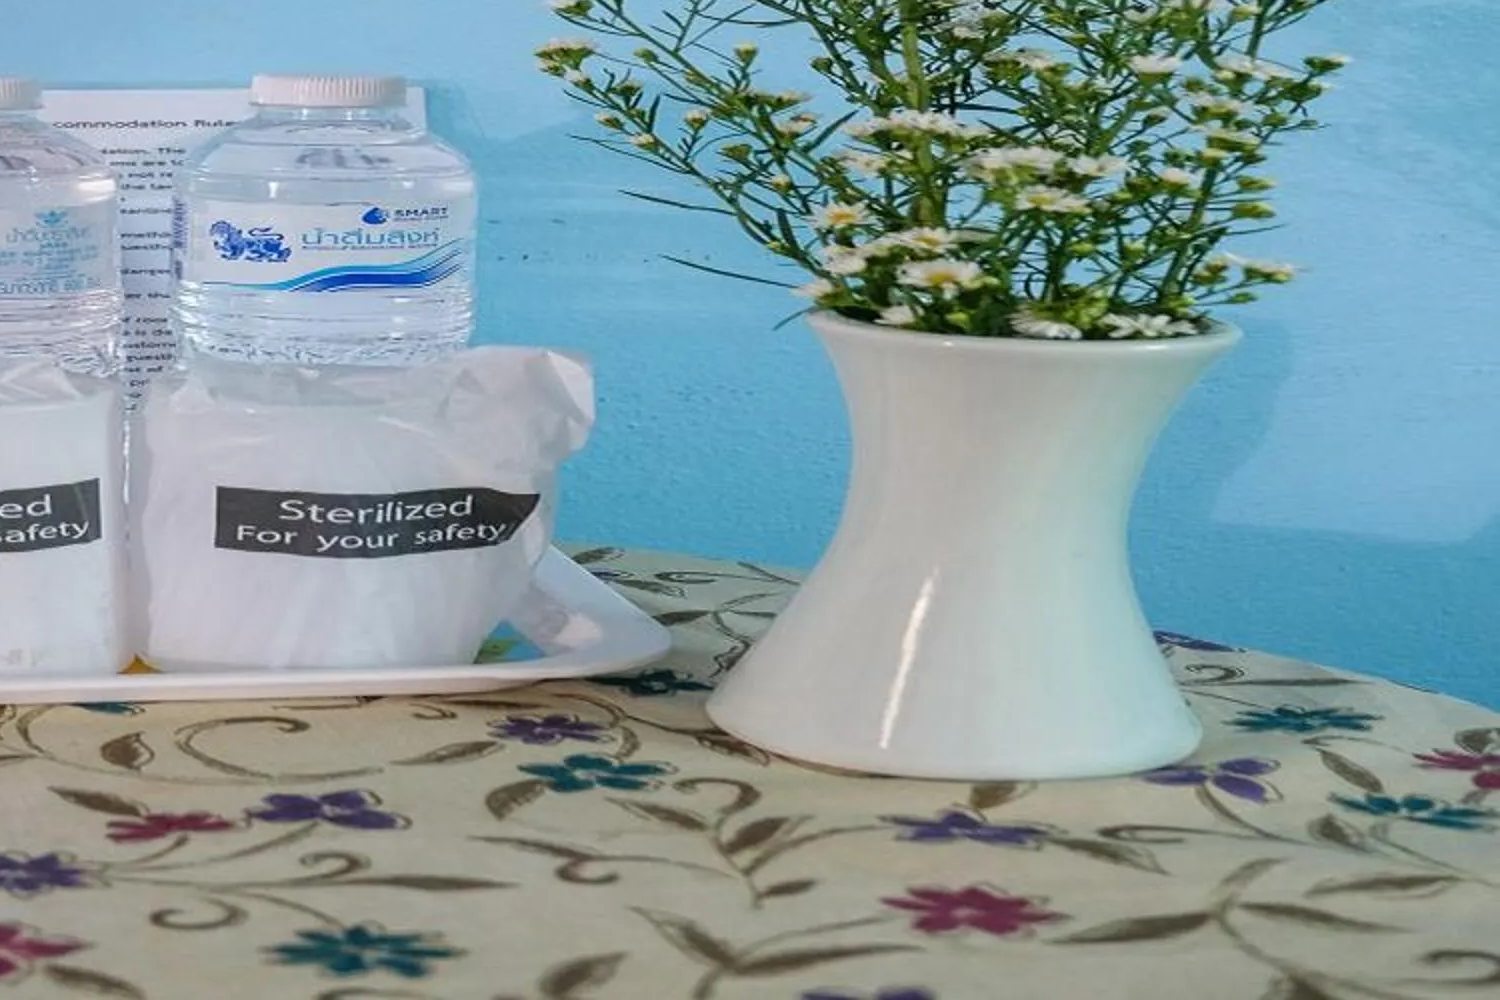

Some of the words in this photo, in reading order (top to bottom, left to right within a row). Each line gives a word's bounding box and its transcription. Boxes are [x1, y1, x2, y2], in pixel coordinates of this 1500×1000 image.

[53, 119, 188, 129] commodation
[393, 207, 448, 217] SMART
[278, 494, 474, 524] Sterilized
[237, 524, 298, 545] For
[316, 532, 399, 552] your
[414, 522, 506, 545] safety
